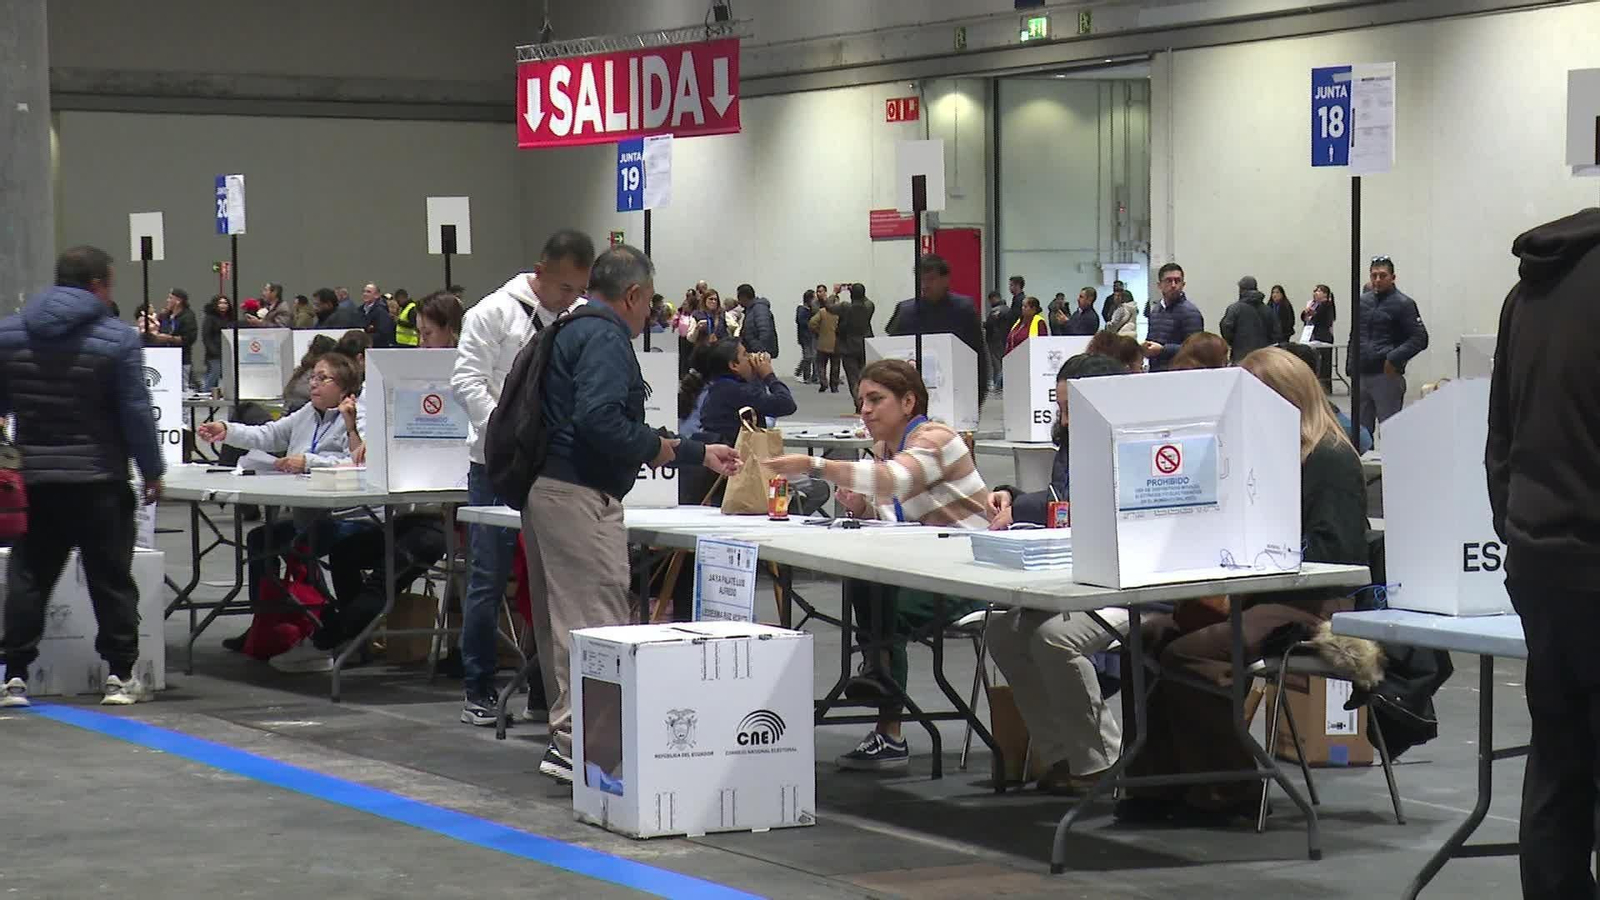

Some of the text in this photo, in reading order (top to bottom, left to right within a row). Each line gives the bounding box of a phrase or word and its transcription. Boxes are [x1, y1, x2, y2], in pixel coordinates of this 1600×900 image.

[548, 51, 704, 136] SALIDA
[1315, 85, 1348, 99] JUNTA
[1318, 105, 1344, 138] 18
[619, 152, 642, 163] JUNTA
[621, 167, 639, 191] 19
[1048, 389, 1057, 402] E
[1146, 477, 1190, 487] PROHIBIDO
[1463, 541, 1501, 572] ES
[736, 731, 769, 746] CNE
